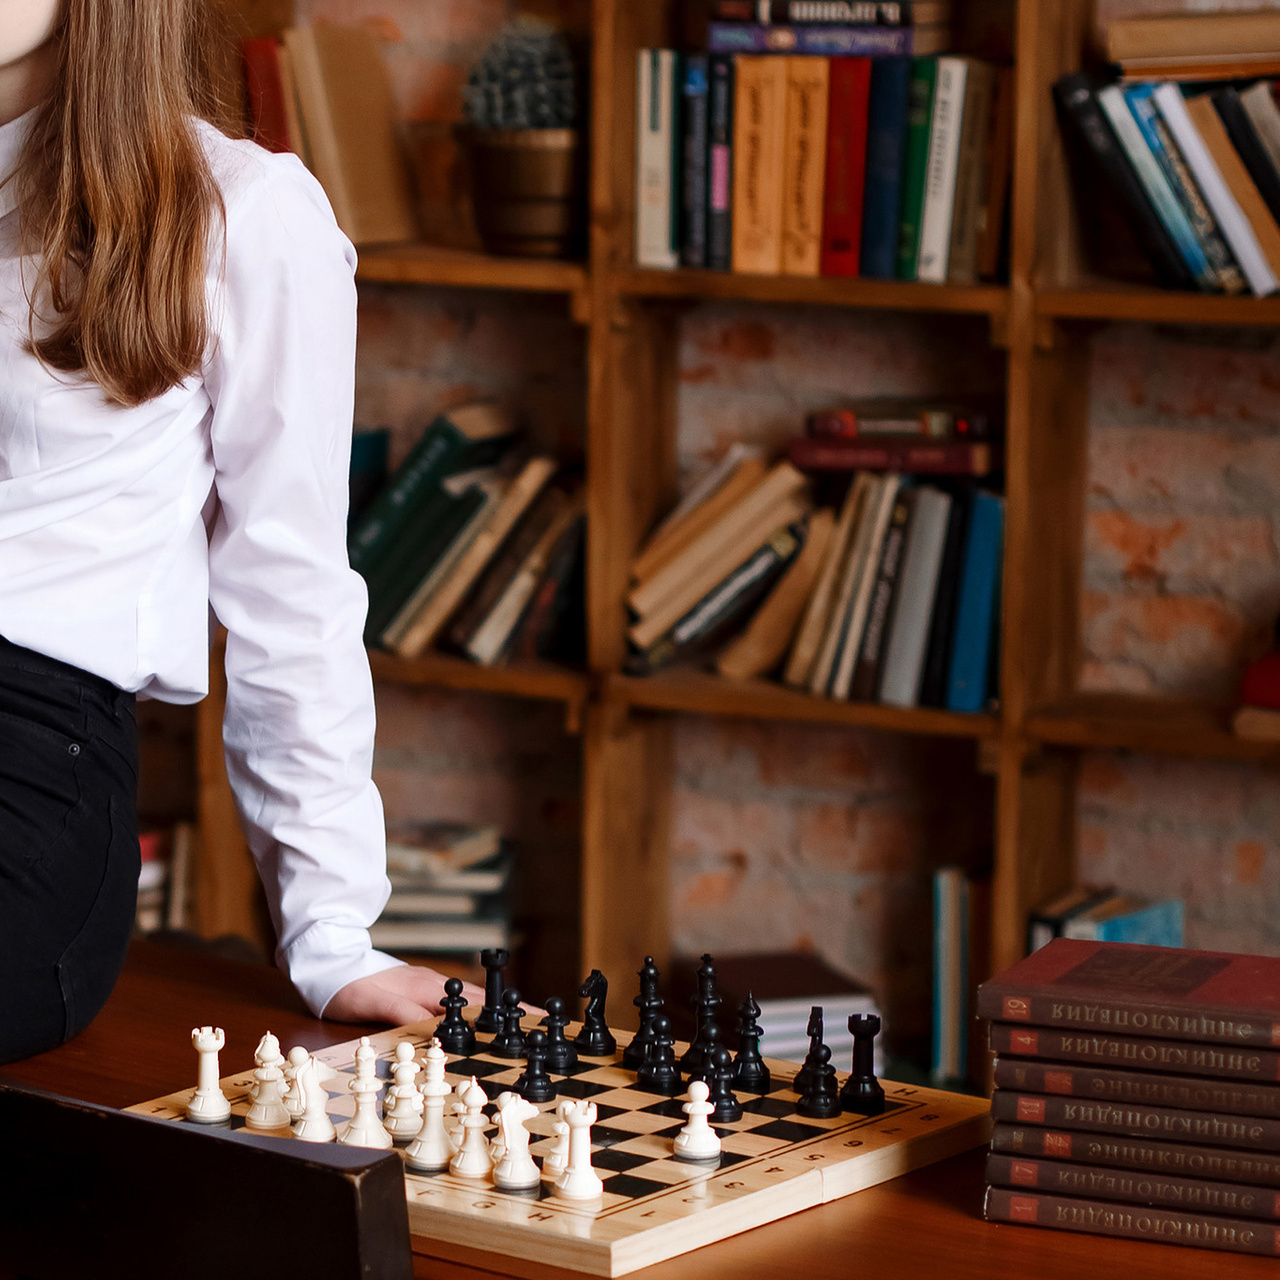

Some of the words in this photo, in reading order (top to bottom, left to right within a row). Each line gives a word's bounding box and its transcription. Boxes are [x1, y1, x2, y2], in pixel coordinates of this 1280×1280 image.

[1006, 999, 1028, 1015] 19
[1051, 1003, 1253, 1039] ЭНЦИКЛОПЕДИЯ
[1017, 1035, 1036, 1045] 4
[1060, 1036, 1261, 1072] ЭНЦИКЛОПЕДИЯ
[1064, 1103, 1265, 1141] ЭНЦИКЛОПЕДИЯ
[1058, 1169, 1255, 1210] ЭНЦИКЛОПЕДИЯ
[1056, 1204, 1255, 1245] ЭНЦИКЛОПЕДИЯ
